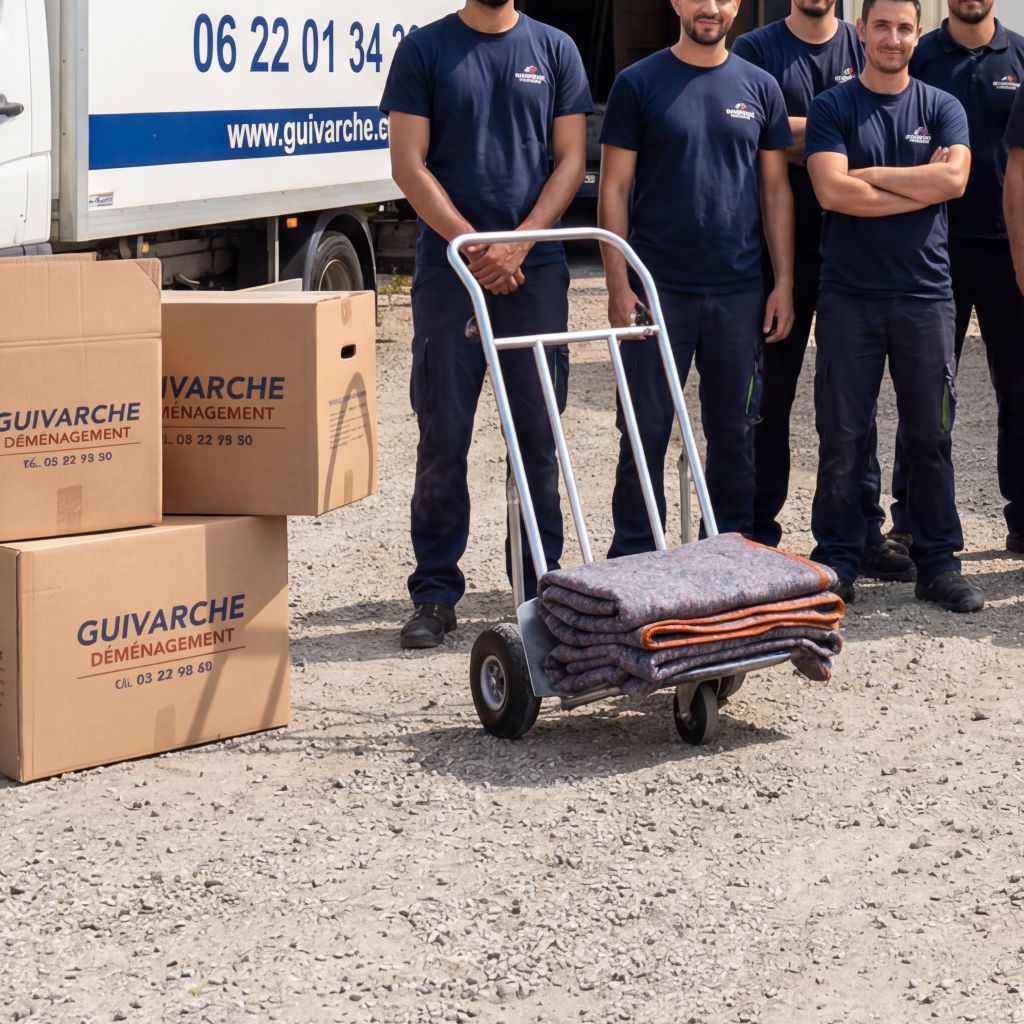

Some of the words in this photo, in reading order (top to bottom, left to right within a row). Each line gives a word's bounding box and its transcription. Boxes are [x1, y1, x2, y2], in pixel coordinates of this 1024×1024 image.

[193, 13, 237, 74] 06
[249, 15, 290, 73] 22
[302, 18, 334, 74] 01
[349, 21, 383, 74] 34
[0, 402, 141, 433] GUIVARCHE
[4, 426, 132, 449] DÉMÉNAGEMENT
[196, 434, 213, 446] 22
[62, 455, 77, 467] 22
[77, 593, 246, 647] GUIVARCHE
[90, 627, 236, 668] DÉMÉNAGEMENT
[136, 672, 153, 686] 03
[156, 668, 174, 682] 22
[177, 664, 194, 679] 98
